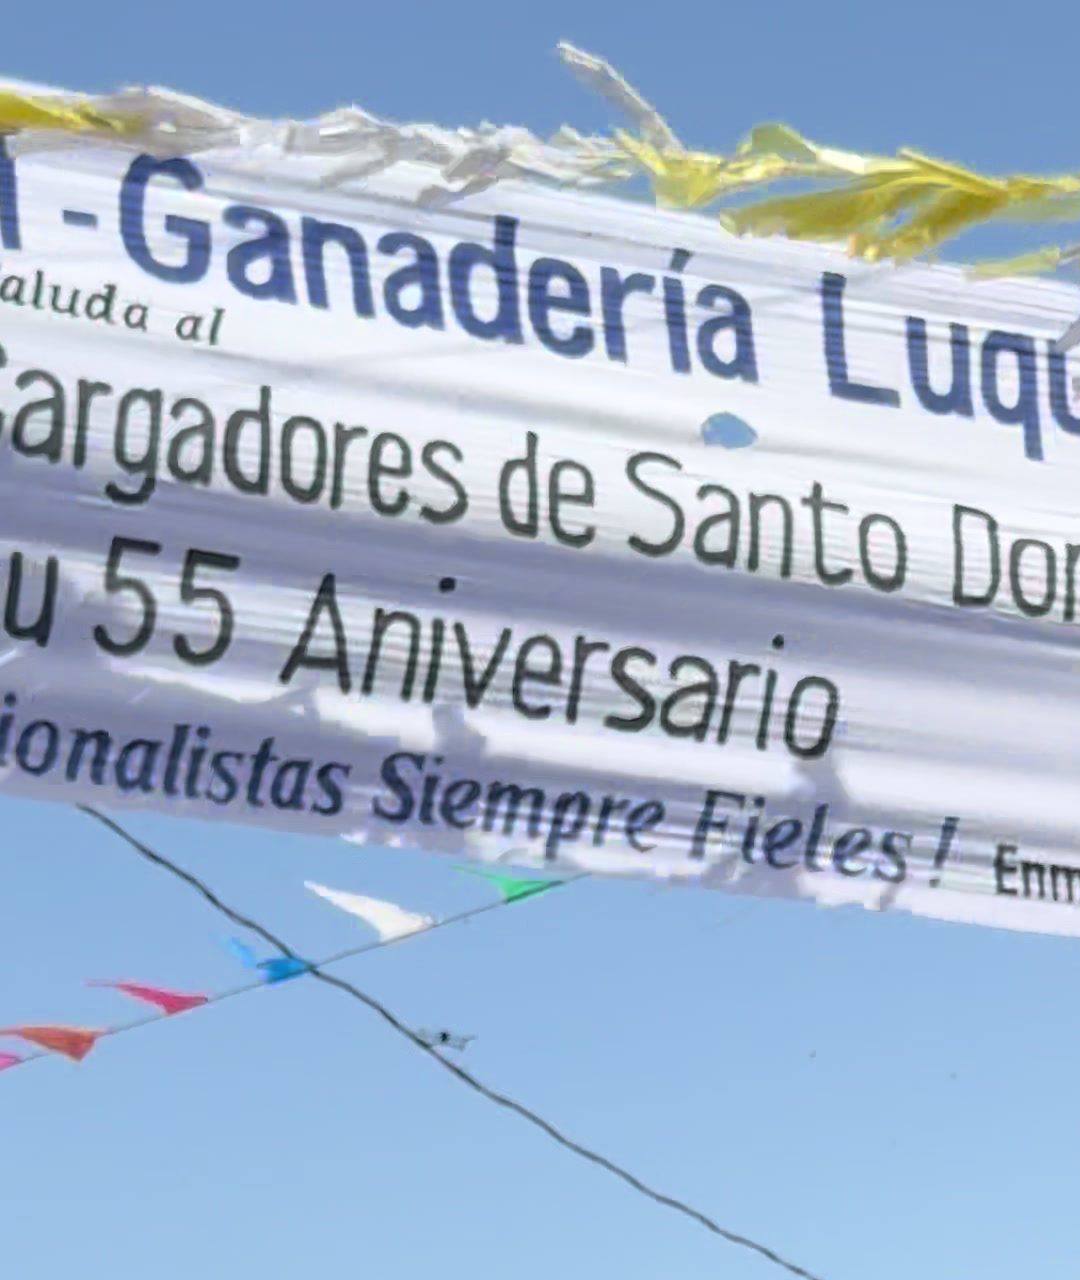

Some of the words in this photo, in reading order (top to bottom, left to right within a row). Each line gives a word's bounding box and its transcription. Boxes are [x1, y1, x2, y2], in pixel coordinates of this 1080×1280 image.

[174, 306, 226, 347] al
[0, 343, 470, 524] argadores
[498, 430, 597, 549] de
[625, 451, 908, 592] Santo
[93, 536, 241, 666] 55
[279, 573, 841, 758] Aniversario
[372, 750, 666, 858] Siempre
